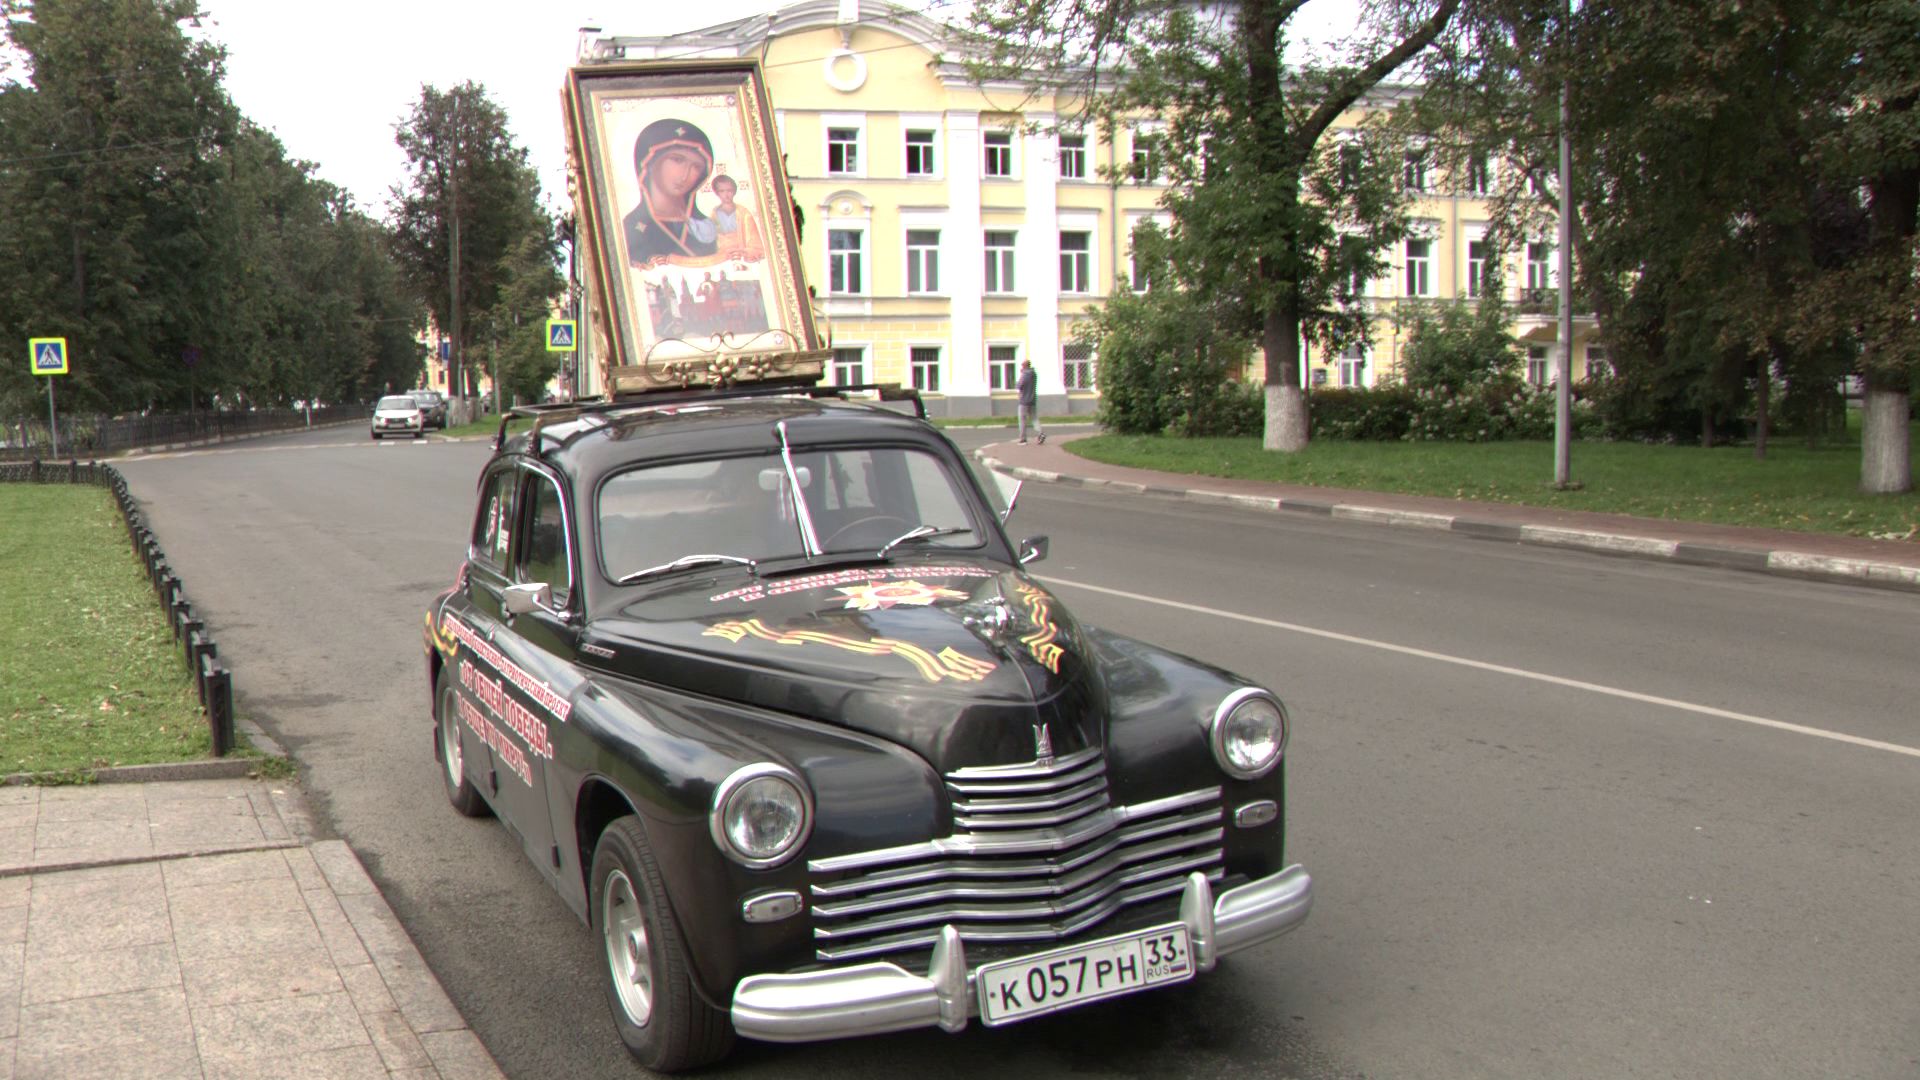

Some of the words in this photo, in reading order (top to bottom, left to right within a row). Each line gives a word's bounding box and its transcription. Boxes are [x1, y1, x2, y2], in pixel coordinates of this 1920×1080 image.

[474, 668, 503, 719] ОБЩЕЙ
[1145, 935, 1177, 966] 33
[1146, 965, 1170, 979] RUS
